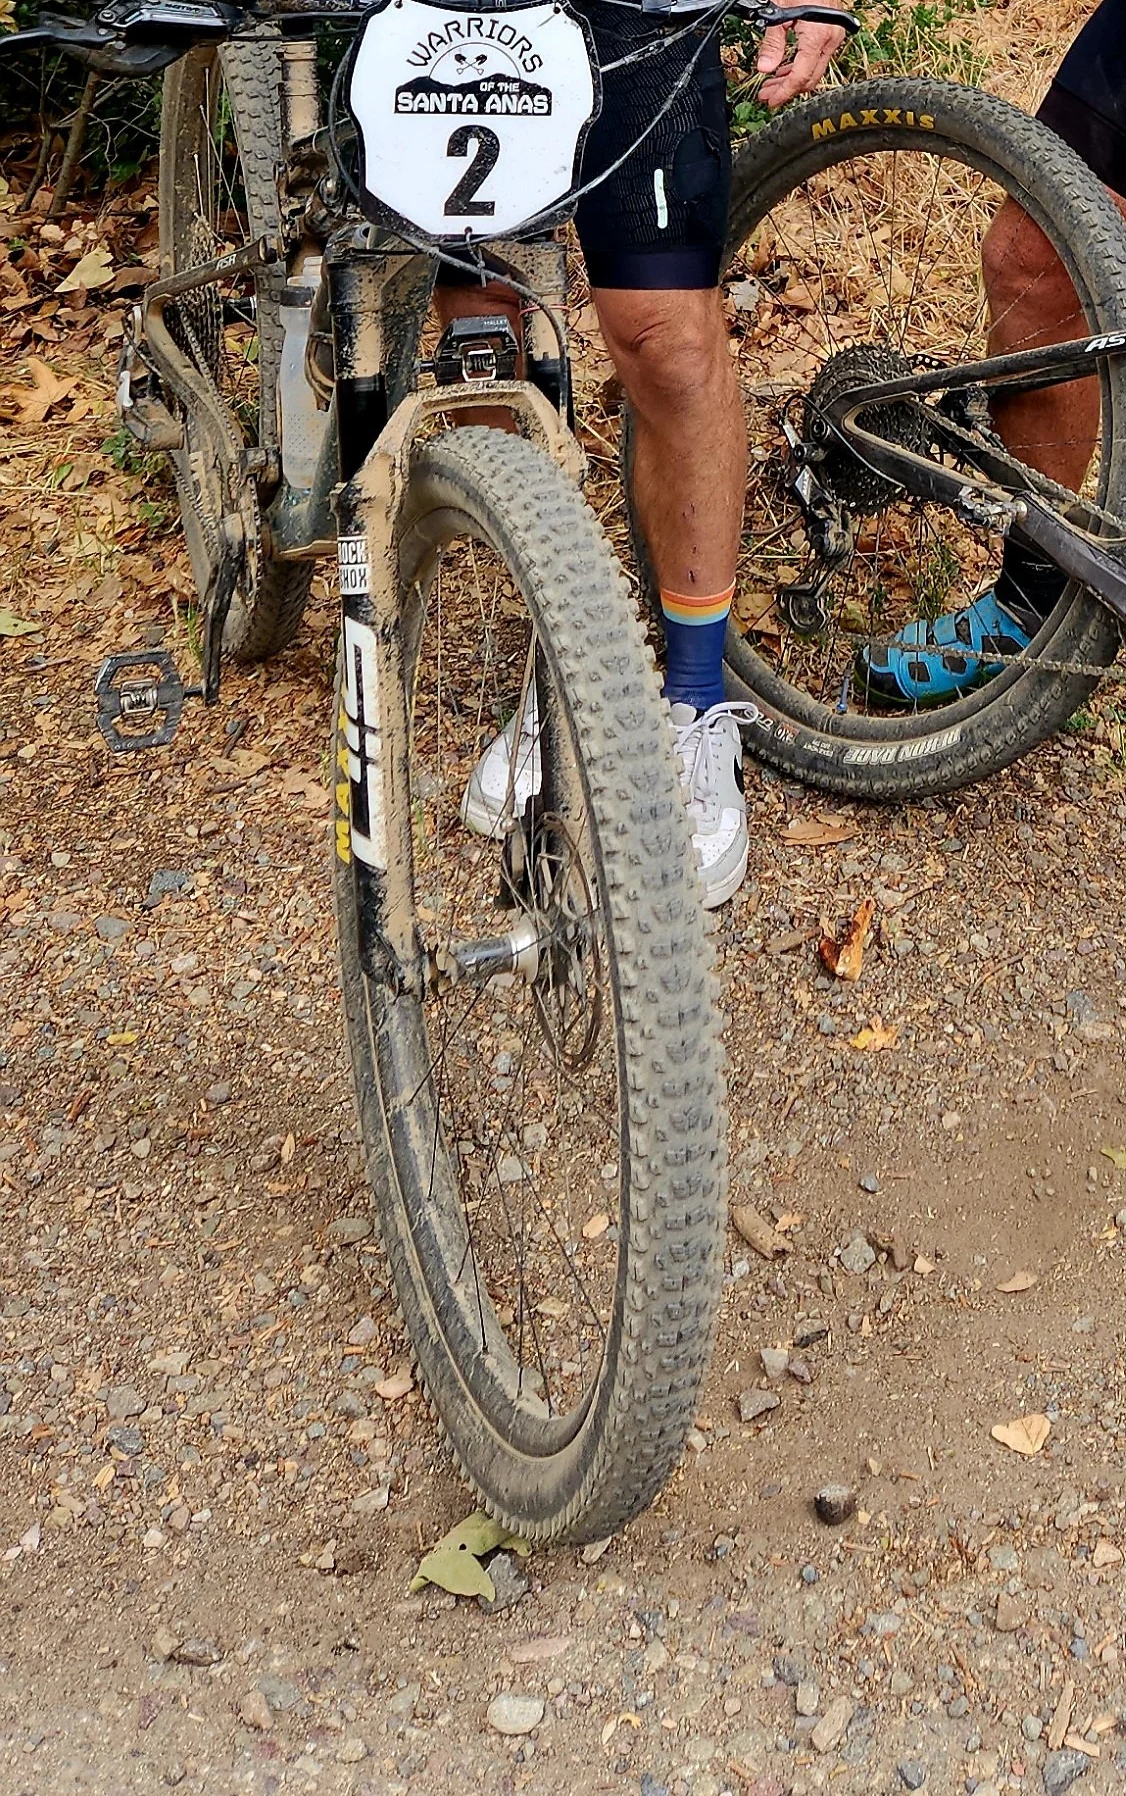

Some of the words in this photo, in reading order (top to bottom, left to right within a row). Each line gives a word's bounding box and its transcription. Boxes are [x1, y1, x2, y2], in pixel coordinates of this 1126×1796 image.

[406, 17, 543, 74] WARRIORS
[397, 92, 479, 113] SANTA
[485, 93, 549, 114] ANAS
[480, 81, 495, 92] OF
[496, 81, 520, 93] THE
[811, 108, 936, 140] MAXXIS
[443, 124, 501, 217] 2
